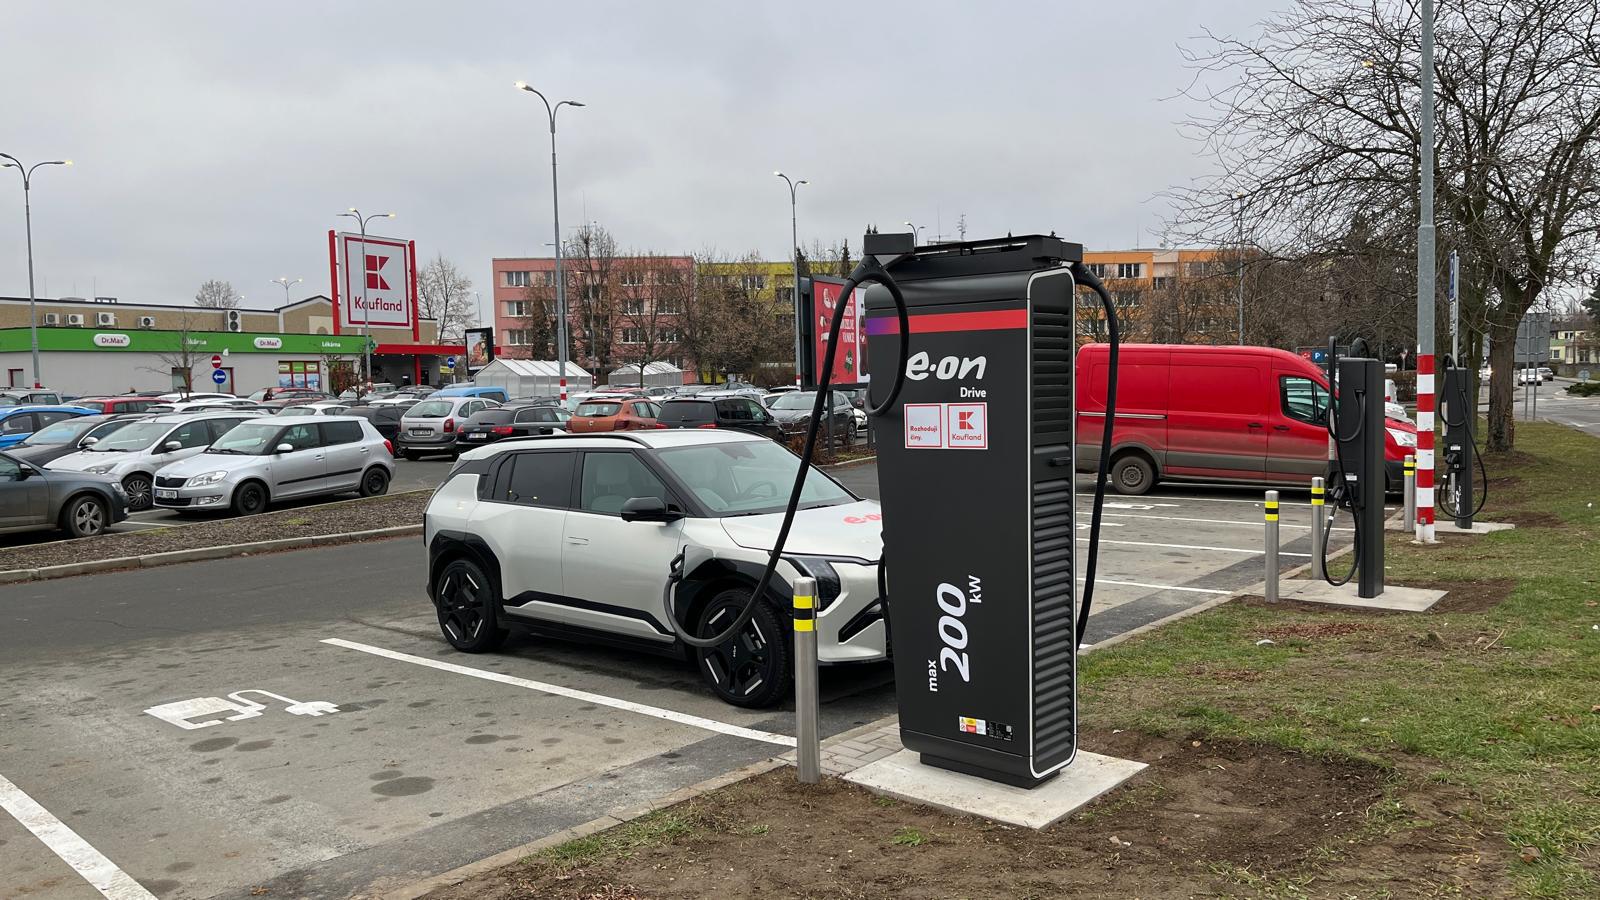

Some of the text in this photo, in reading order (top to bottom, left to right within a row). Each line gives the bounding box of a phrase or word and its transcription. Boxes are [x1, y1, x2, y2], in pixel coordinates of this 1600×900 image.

[354, 296, 402, 311] Kaufland
[960, 387, 987, 398] Drive
[951, 433, 982, 441] Kaufland
[927, 575, 982, 692] max 200 kW
